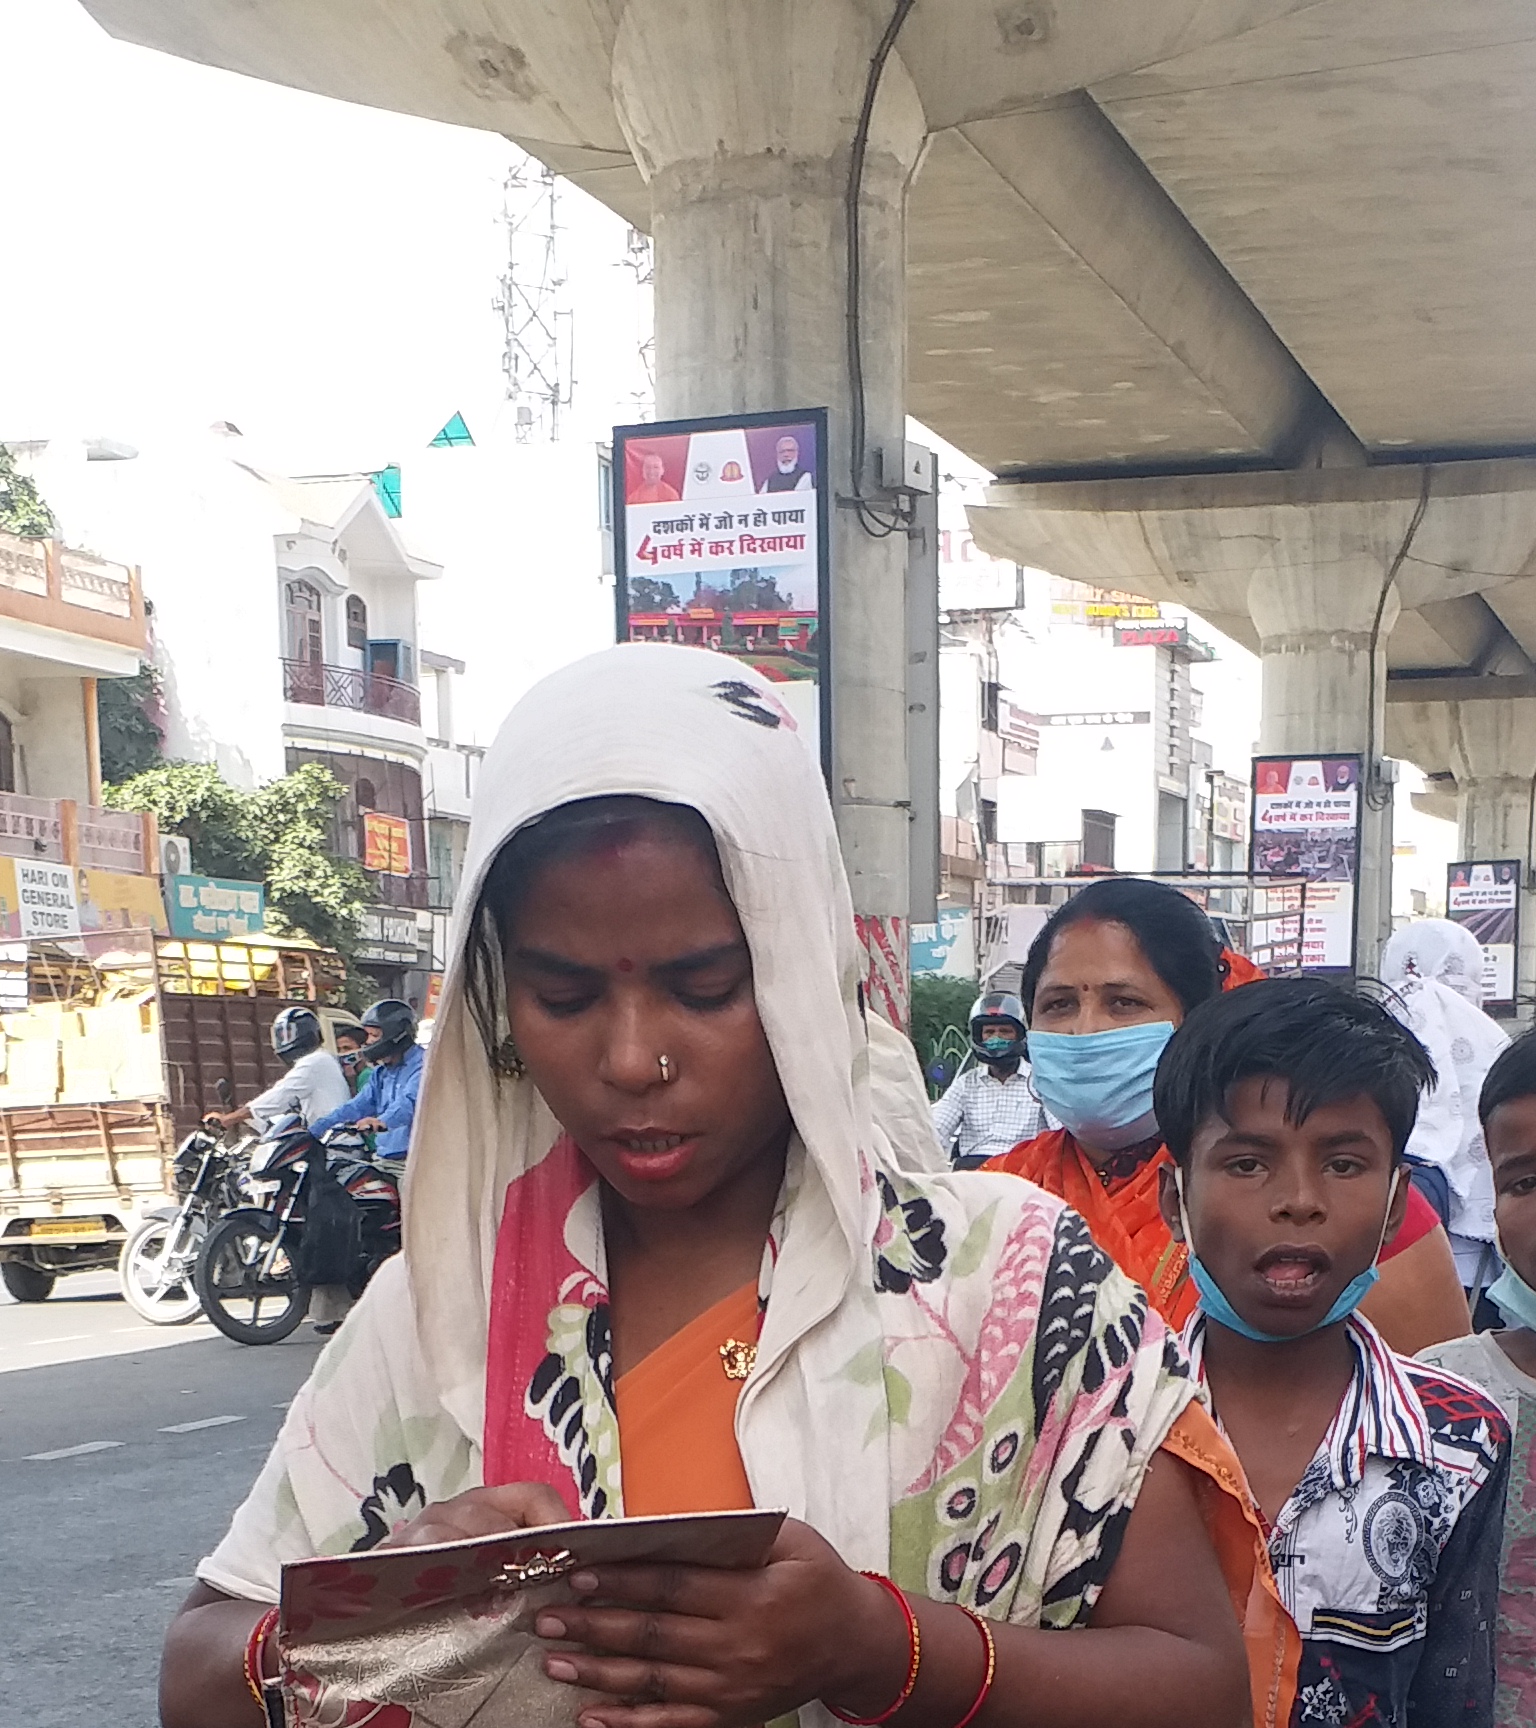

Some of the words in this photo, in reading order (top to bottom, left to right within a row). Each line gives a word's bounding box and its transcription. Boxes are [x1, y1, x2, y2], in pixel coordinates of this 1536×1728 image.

[652, 514, 695, 535] दशकों
[699, 513, 711, 531] में
[714, 511, 733, 529] जो
[738, 514, 749, 528] न
[753, 509, 767, 528] हो
[772, 509, 805, 525] पाया
[659, 539, 685, 560] वर्ष
[689, 537, 705, 557] में
[708, 540, 735, 556] कर
[739, 534, 806, 554] दिखाया
[1121, 630, 1179, 644] PLAZA
[21, 868, 48, 888] HARI
[51, 872, 69, 889] OM
[22, 889, 75, 910] GENERAL
[32, 911, 69, 929] STORE
